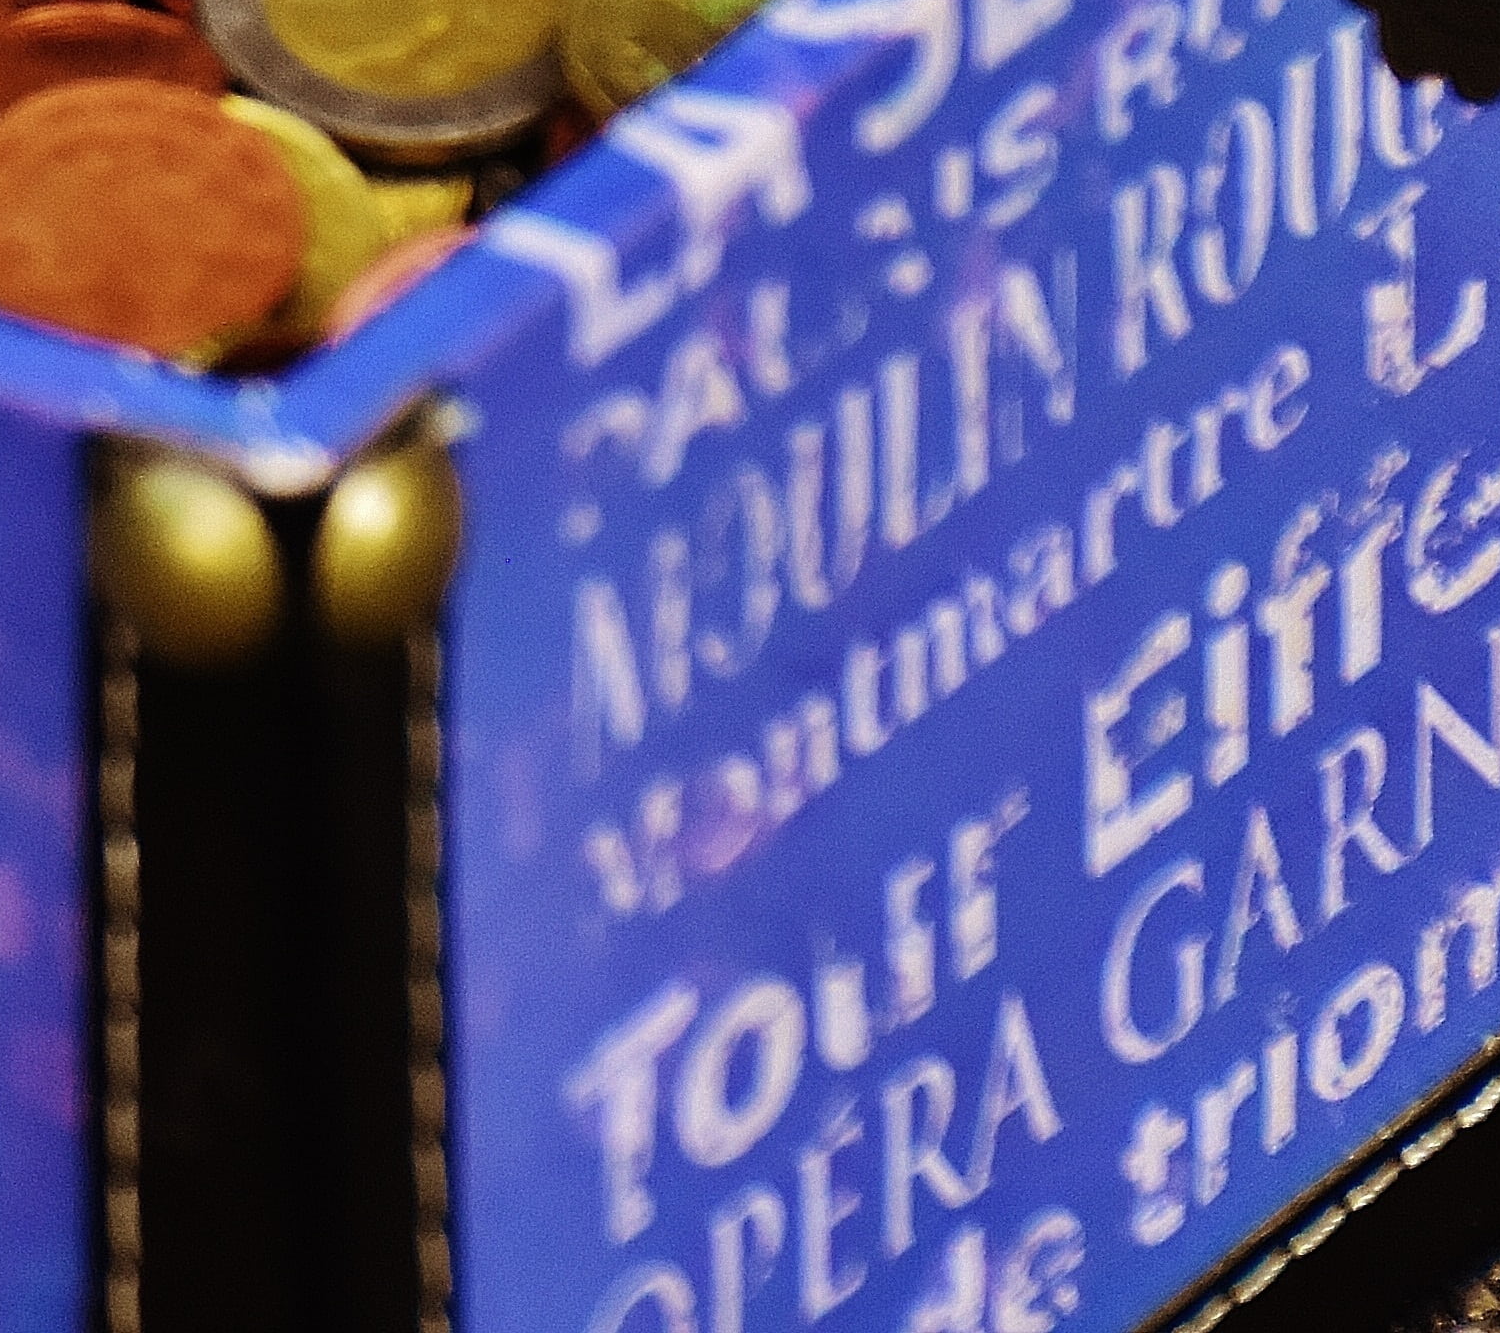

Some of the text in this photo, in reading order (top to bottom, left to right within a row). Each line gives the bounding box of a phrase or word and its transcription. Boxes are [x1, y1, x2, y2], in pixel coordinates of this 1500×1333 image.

[478, 80, 812, 367] LA
[1112, 21, 1444, 375] ROU
[584, 343, 1312, 915] Montmartre
